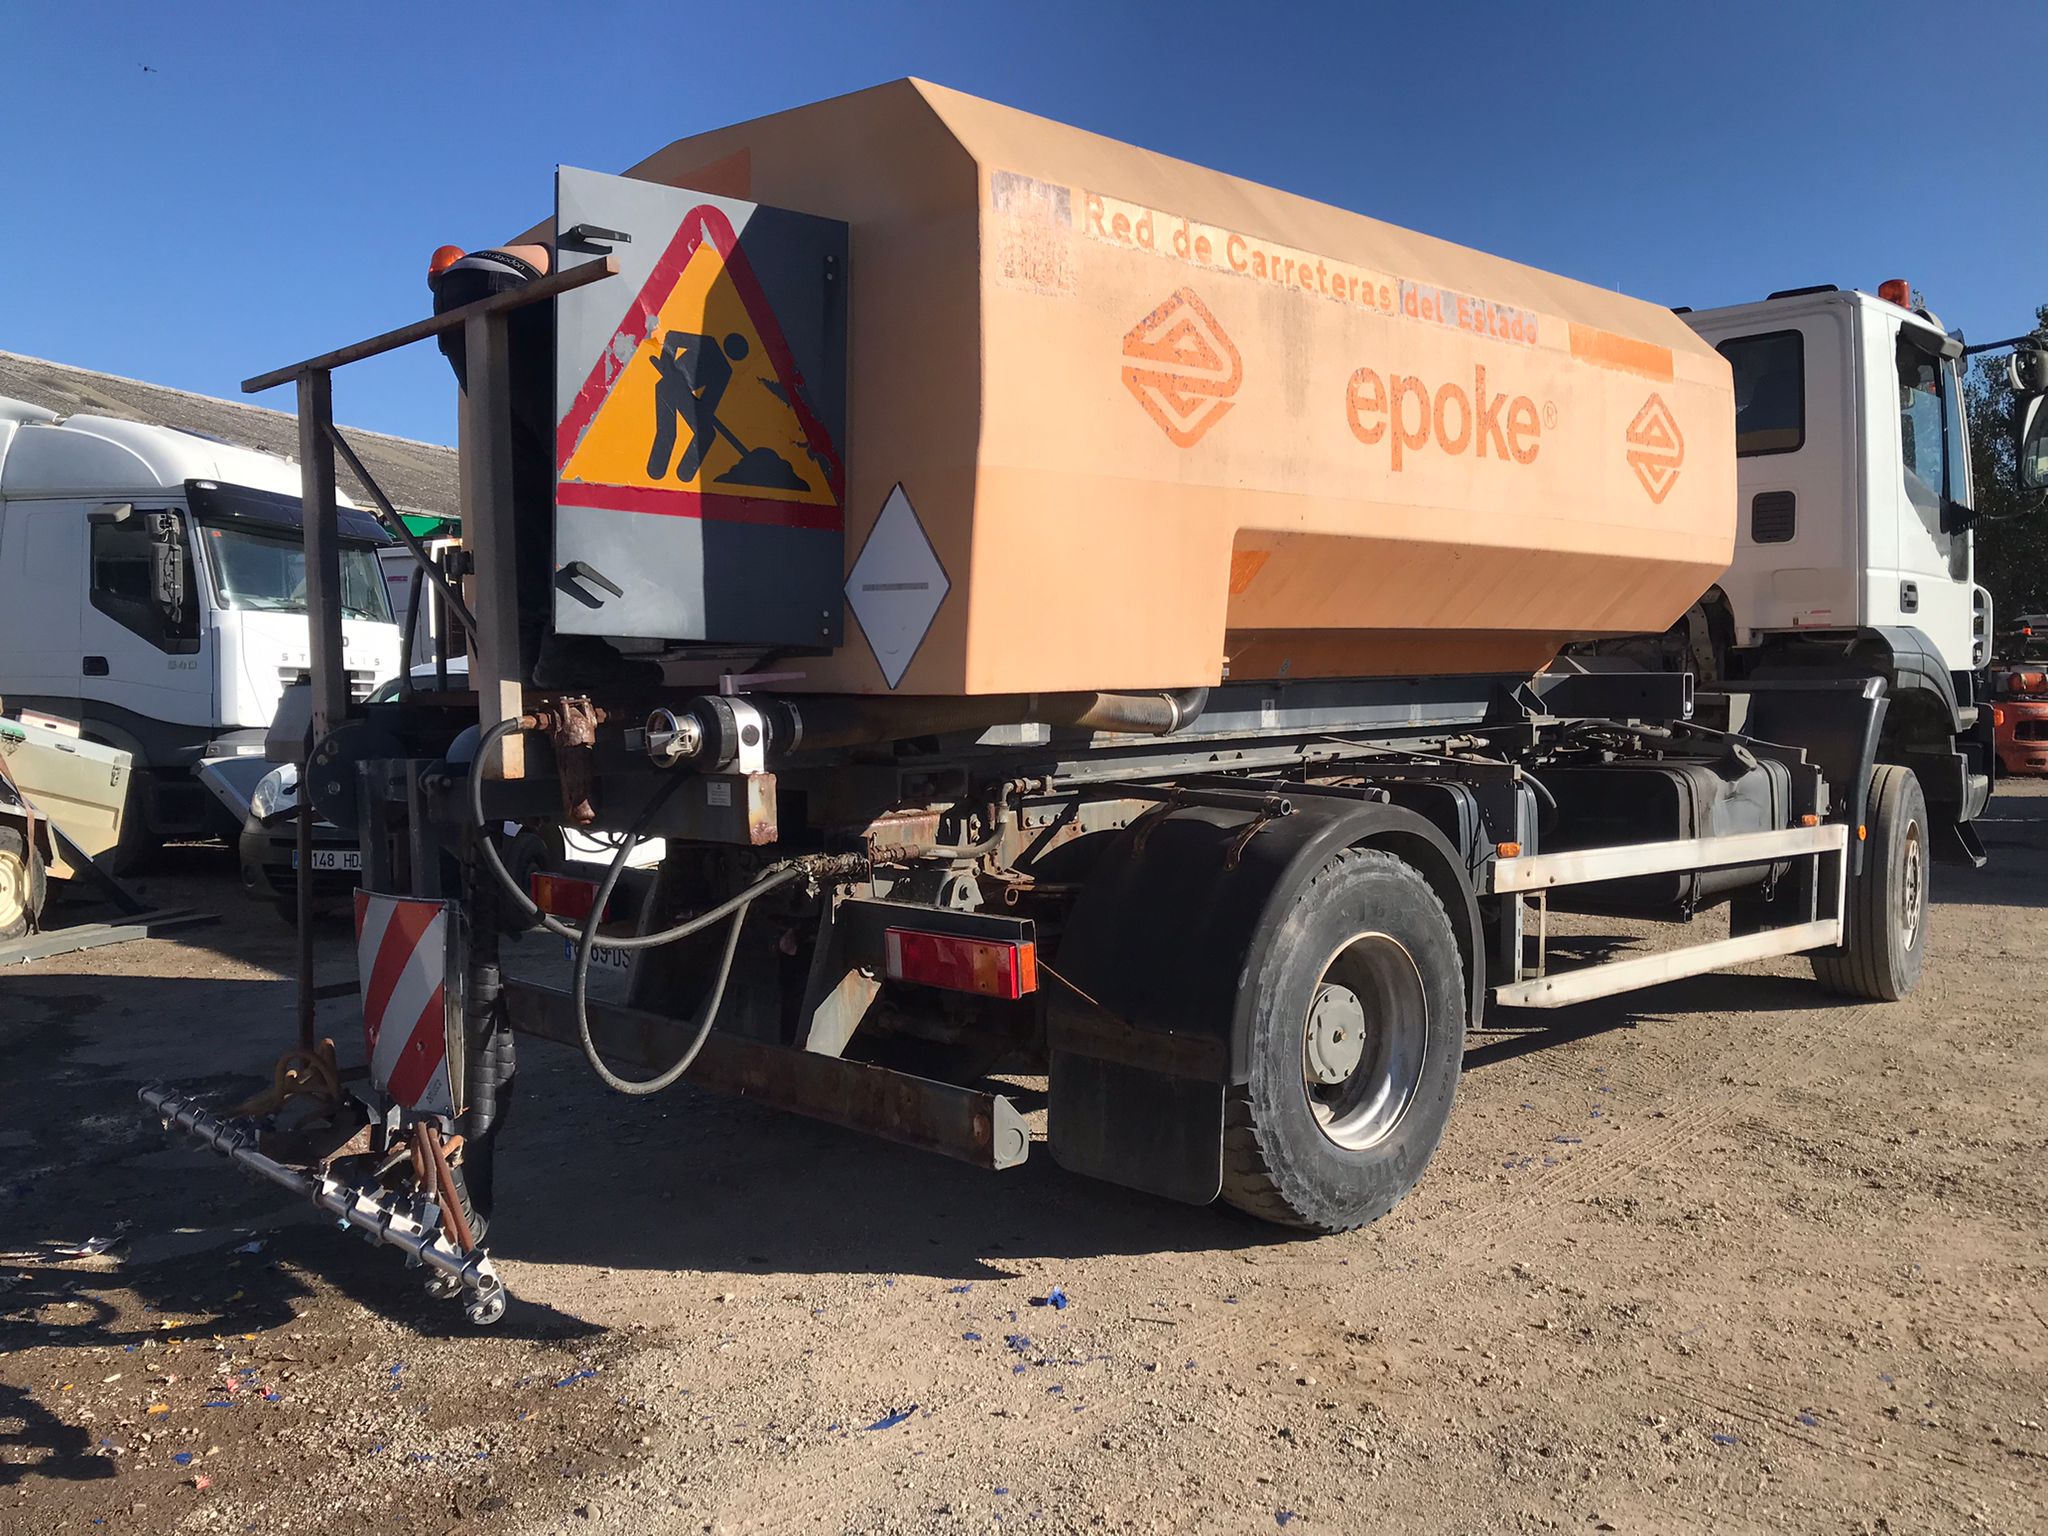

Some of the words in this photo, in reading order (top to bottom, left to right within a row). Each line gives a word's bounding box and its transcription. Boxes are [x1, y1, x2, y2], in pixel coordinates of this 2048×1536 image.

[1084, 192, 1155, 249] Red
[1173, 217, 1212, 264] de
[1226, 234, 1391, 309] Carreteras
[1404, 286, 1444, 323] del
[1456, 296, 1537, 345] Estado
[281, 652, 380, 667] STLIS
[343, 853, 362, 869] HD
